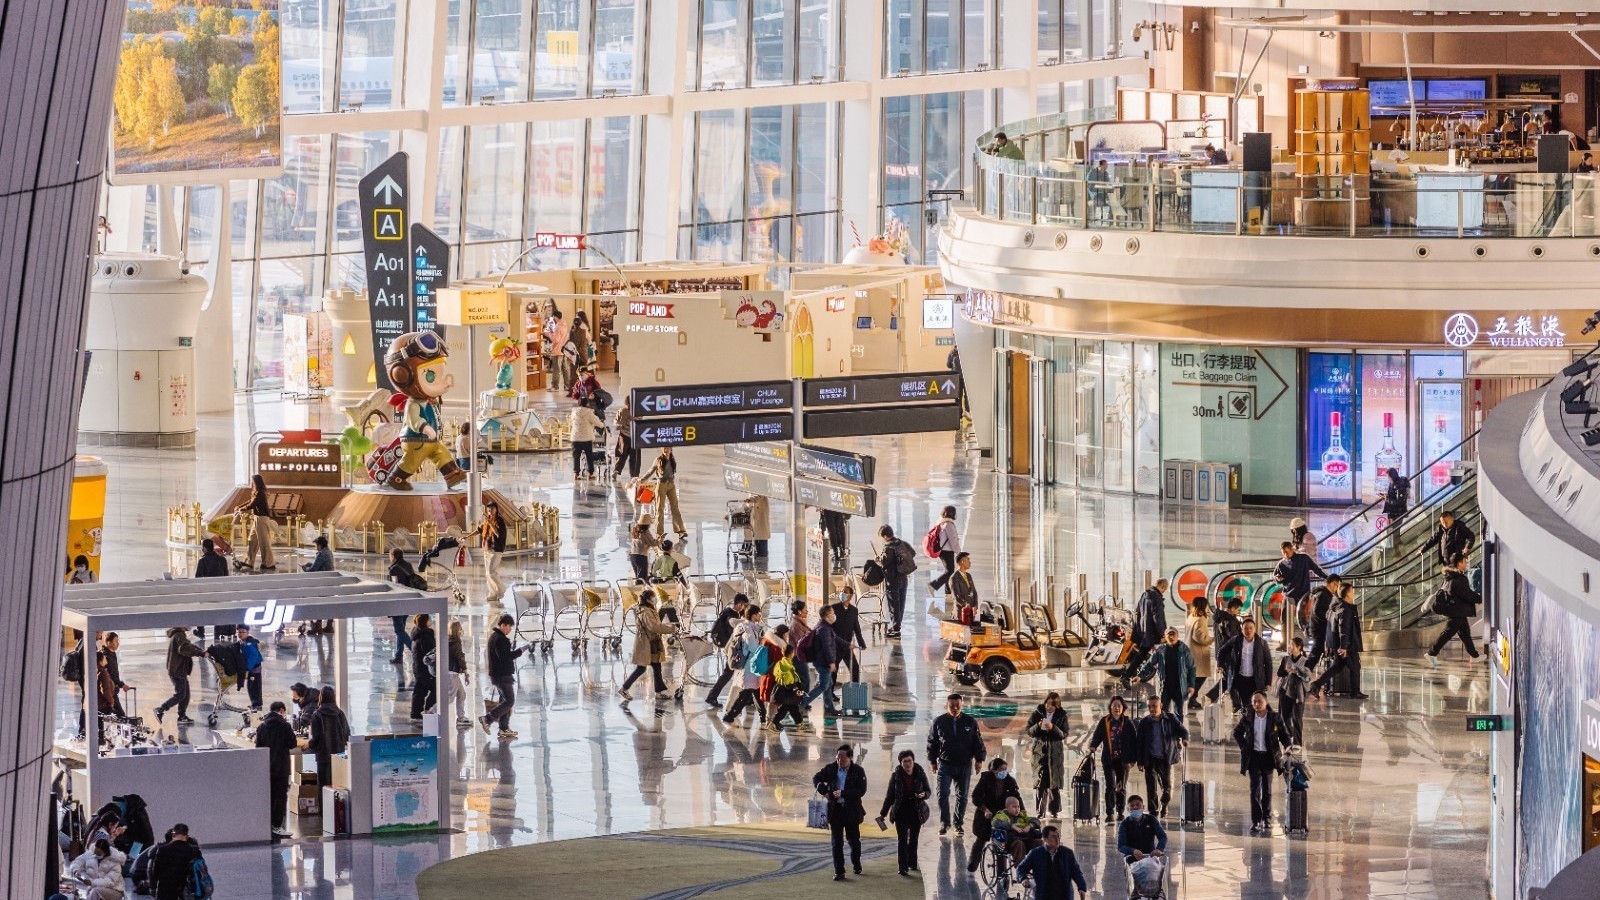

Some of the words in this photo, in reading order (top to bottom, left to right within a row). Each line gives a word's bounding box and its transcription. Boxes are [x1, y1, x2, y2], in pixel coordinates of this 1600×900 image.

[380, 215, 397, 235] A
[538, 234, 555, 246] POP
[556, 236, 579, 248] LAND
[374, 253, 404, 271] A01
[375, 288, 404, 307] A11
[630, 303, 644, 314] POP
[646, 305, 667, 317] LAND
[1487, 316, 1566, 336] 五粮液
[1489, 338, 1564, 347] WULIANGYE
[1171, 352, 1257, 370] 出口、行李提取
[1200, 371, 1233, 382] Baggage
[1235, 373, 1257, 382] Claim
[901, 381, 926, 391] 候机区
[928, 380, 939, 394] A
[1192, 406, 1215, 417] 30m
[657, 426, 683, 436] 候机区
[685, 426, 696, 440] B
[269, 448, 328, 457] DEPARTURES
